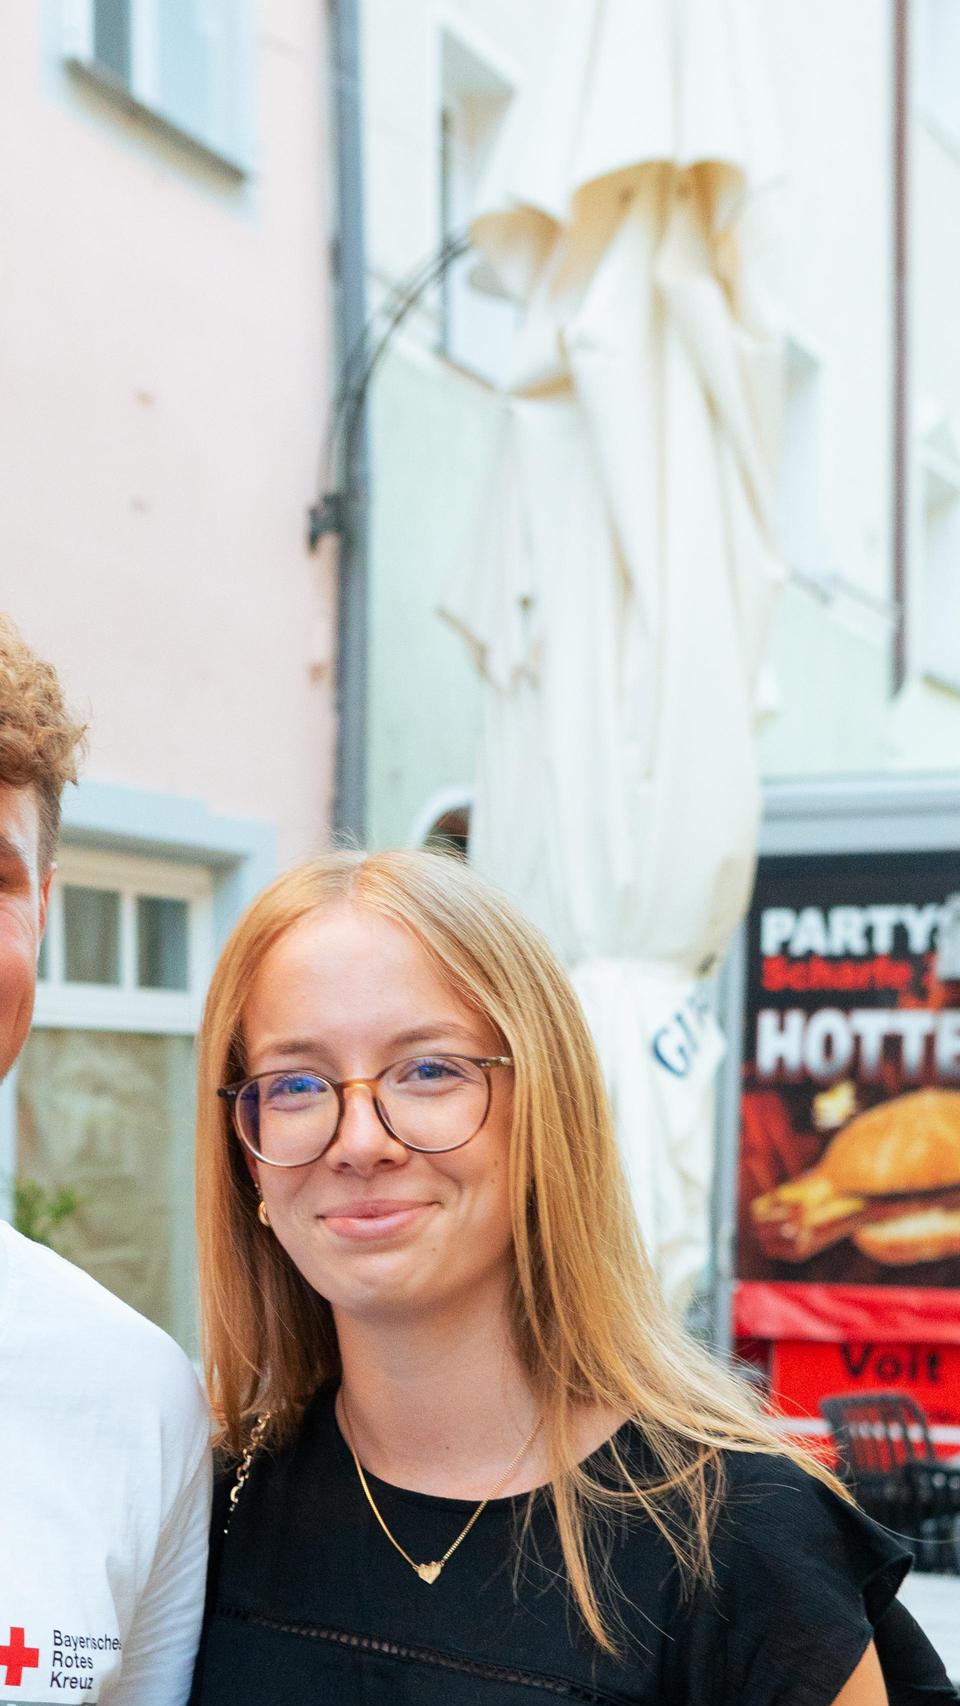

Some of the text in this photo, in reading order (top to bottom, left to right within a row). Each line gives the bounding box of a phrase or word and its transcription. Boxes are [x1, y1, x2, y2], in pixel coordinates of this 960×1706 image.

[760, 904, 939, 957] PARTY
[52, 1651, 94, 1669] Rotes
[50, 1671, 93, 1690] Kreuz
